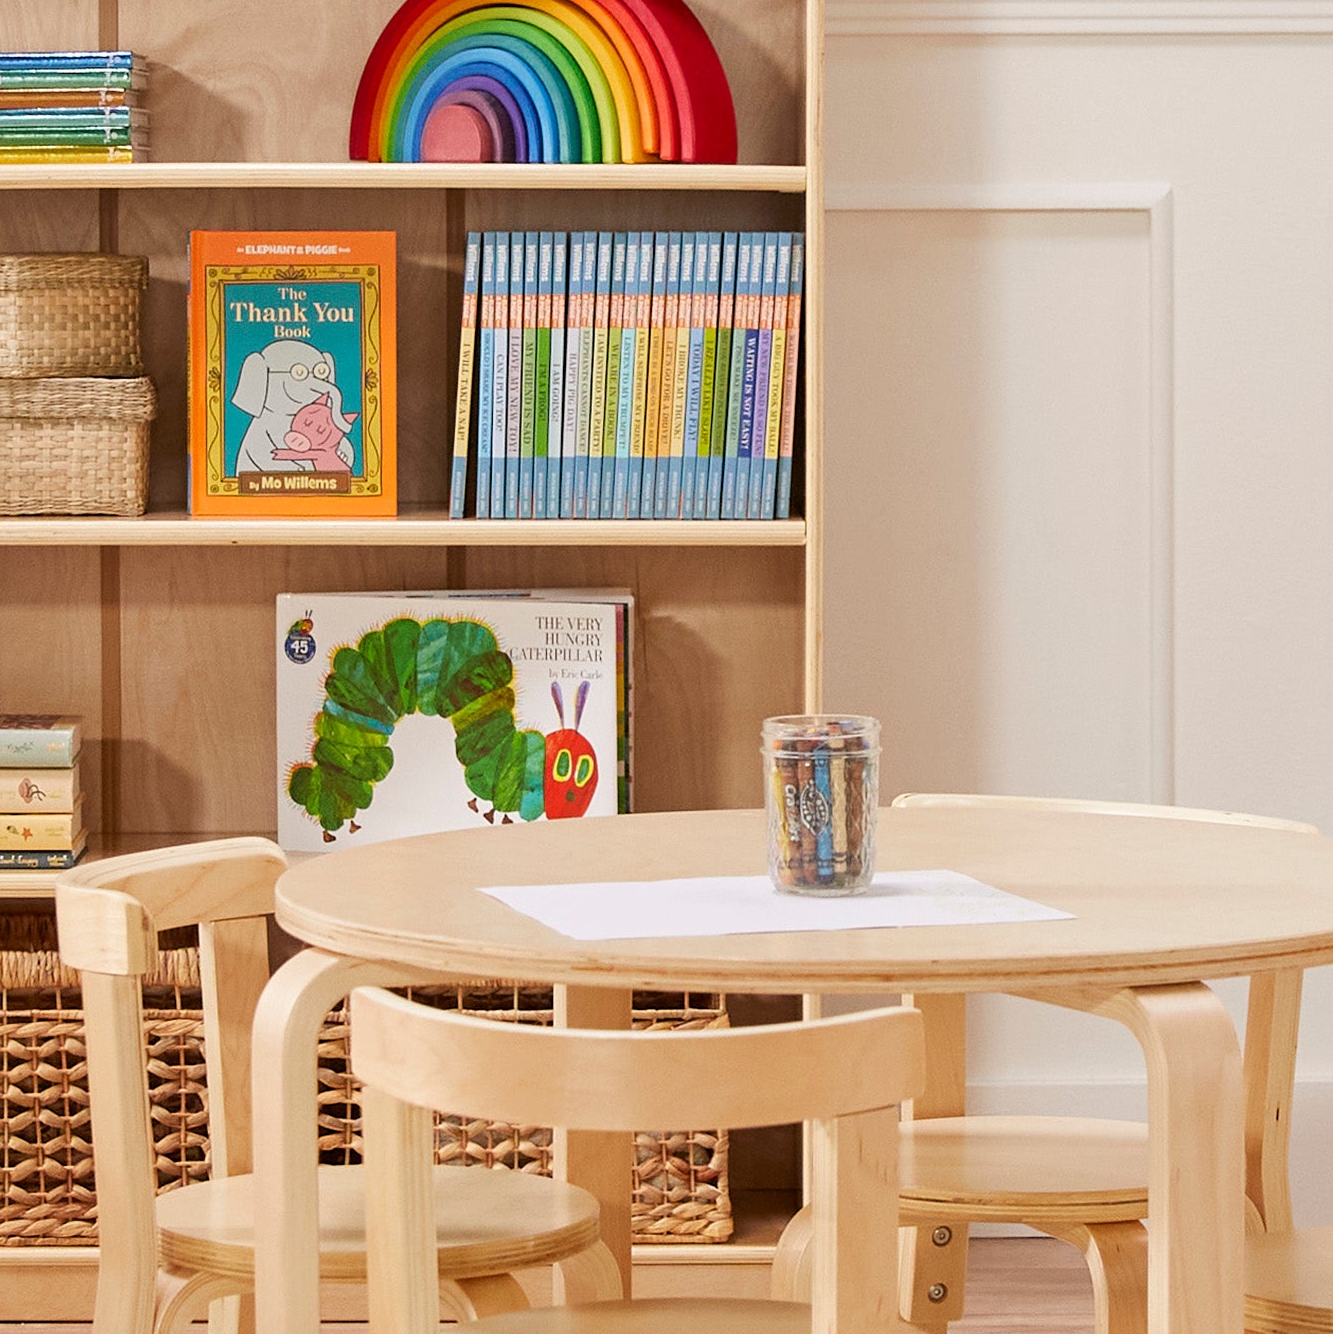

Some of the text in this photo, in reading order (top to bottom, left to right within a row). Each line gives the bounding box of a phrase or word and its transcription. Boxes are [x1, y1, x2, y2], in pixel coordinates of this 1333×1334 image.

[245, 245, 296, 255] ELEPHANT
[305, 245, 337, 255] PIGGIE
[278, 288, 306, 300] The
[230, 302, 354, 322] Thank You
[274, 325, 311, 338] Book
[511, 343, 519, 372] LOVE
[612, 344, 619, 360] WE
[693, 343, 701, 375] TODAY
[462, 348, 470, 373] WILL
[568, 353, 576, 384] HAPPY
[677, 350, 685, 383] BROKE
[511, 377, 518, 391] MY
[553, 370, 560, 385] AM
[460, 376, 468, 404] TAKE
[523, 342, 533, 444] MY FRIEND IS SAD
[609, 387, 616, 396] IN
[677, 387, 684, 399] MY
[741, 337, 755, 449] WAITING IS NOT EASY!
[690, 387, 699, 415] WILL
[457, 417, 466, 440] NAP!
[688, 417, 697, 440] FLY!
[509, 427, 517, 452] TOY!
[262, 477, 282, 489] Mo
[284, 477, 337, 489] Willems
[536, 617, 602, 630] THE VERY
[291, 640, 309, 653] 45
[546, 633, 602, 646] HUNGRY
[509, 648, 602, 661] CATERPILLAR
[562, 669, 576, 677] Eric
[581, 669, 602, 679] Carle
